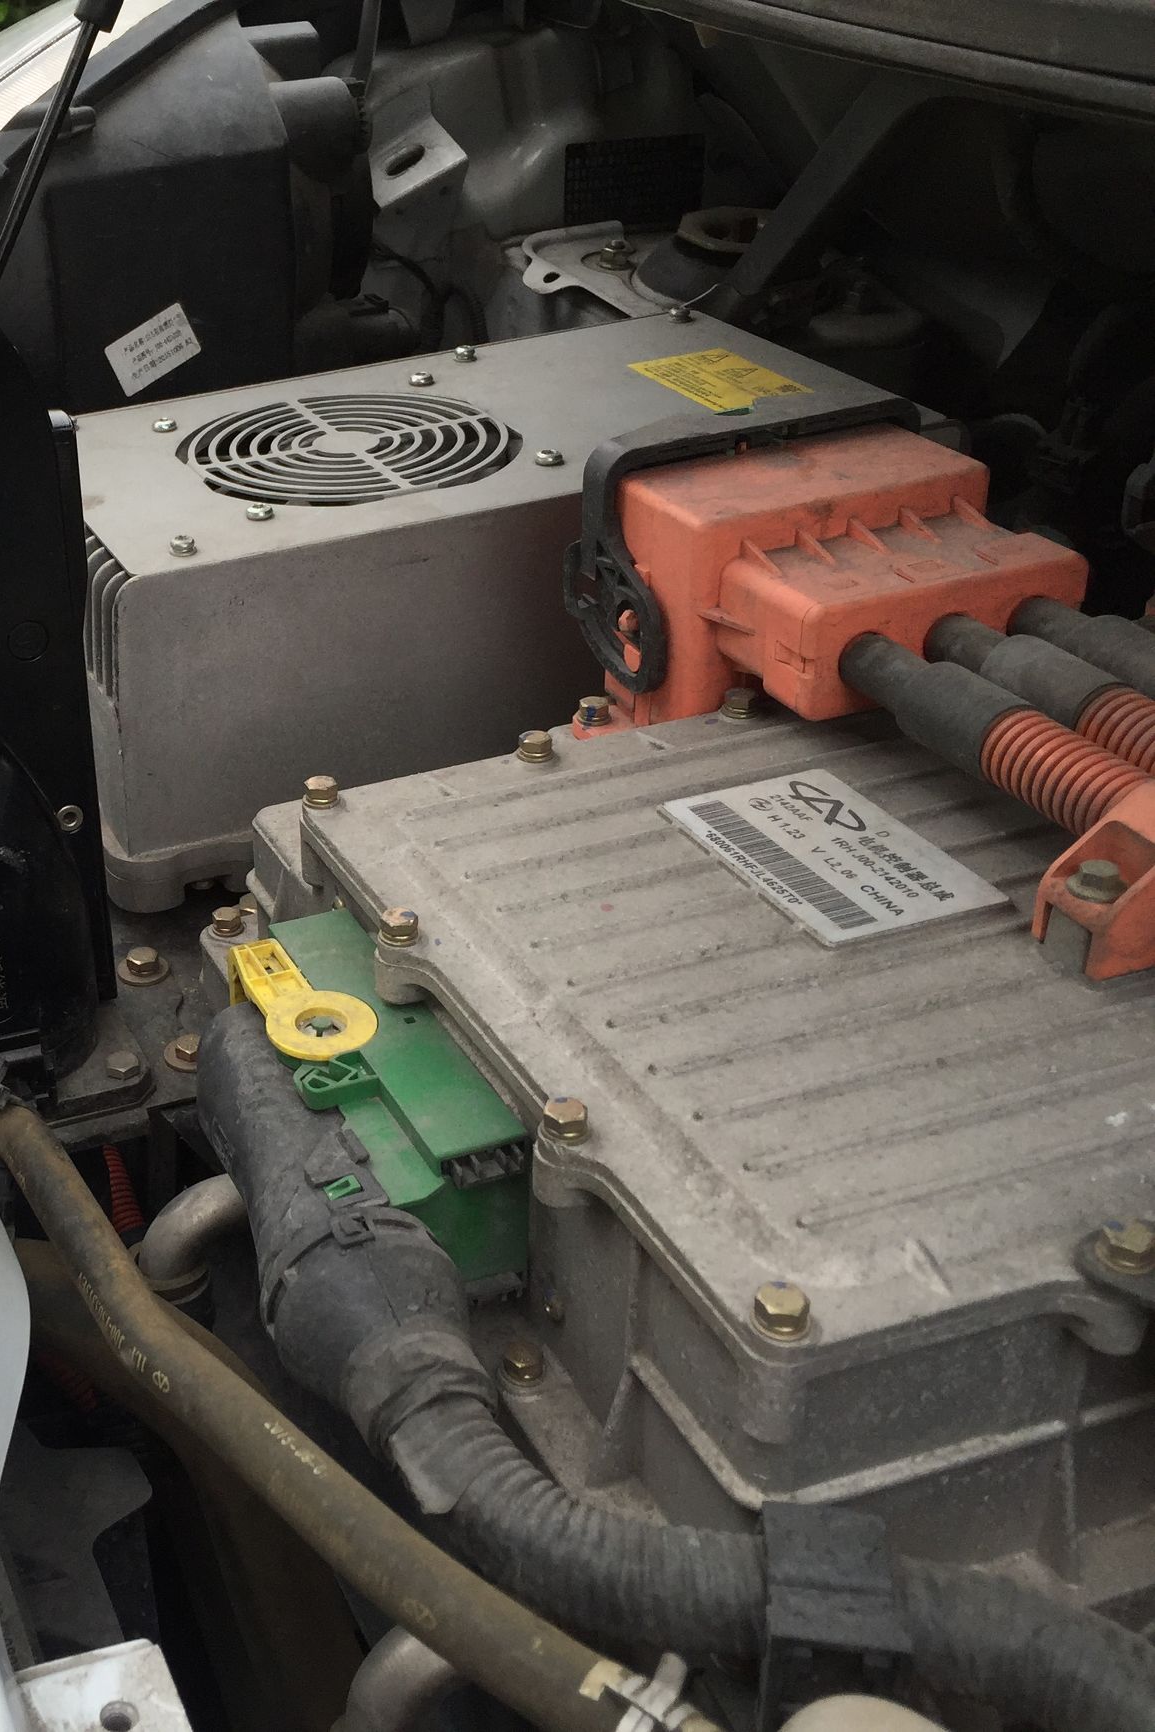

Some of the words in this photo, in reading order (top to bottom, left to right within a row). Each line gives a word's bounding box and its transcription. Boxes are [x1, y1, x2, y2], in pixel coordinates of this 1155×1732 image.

[857, 835, 955, 902] 电机控制器总成
[860, 884, 904, 916] CHINA
